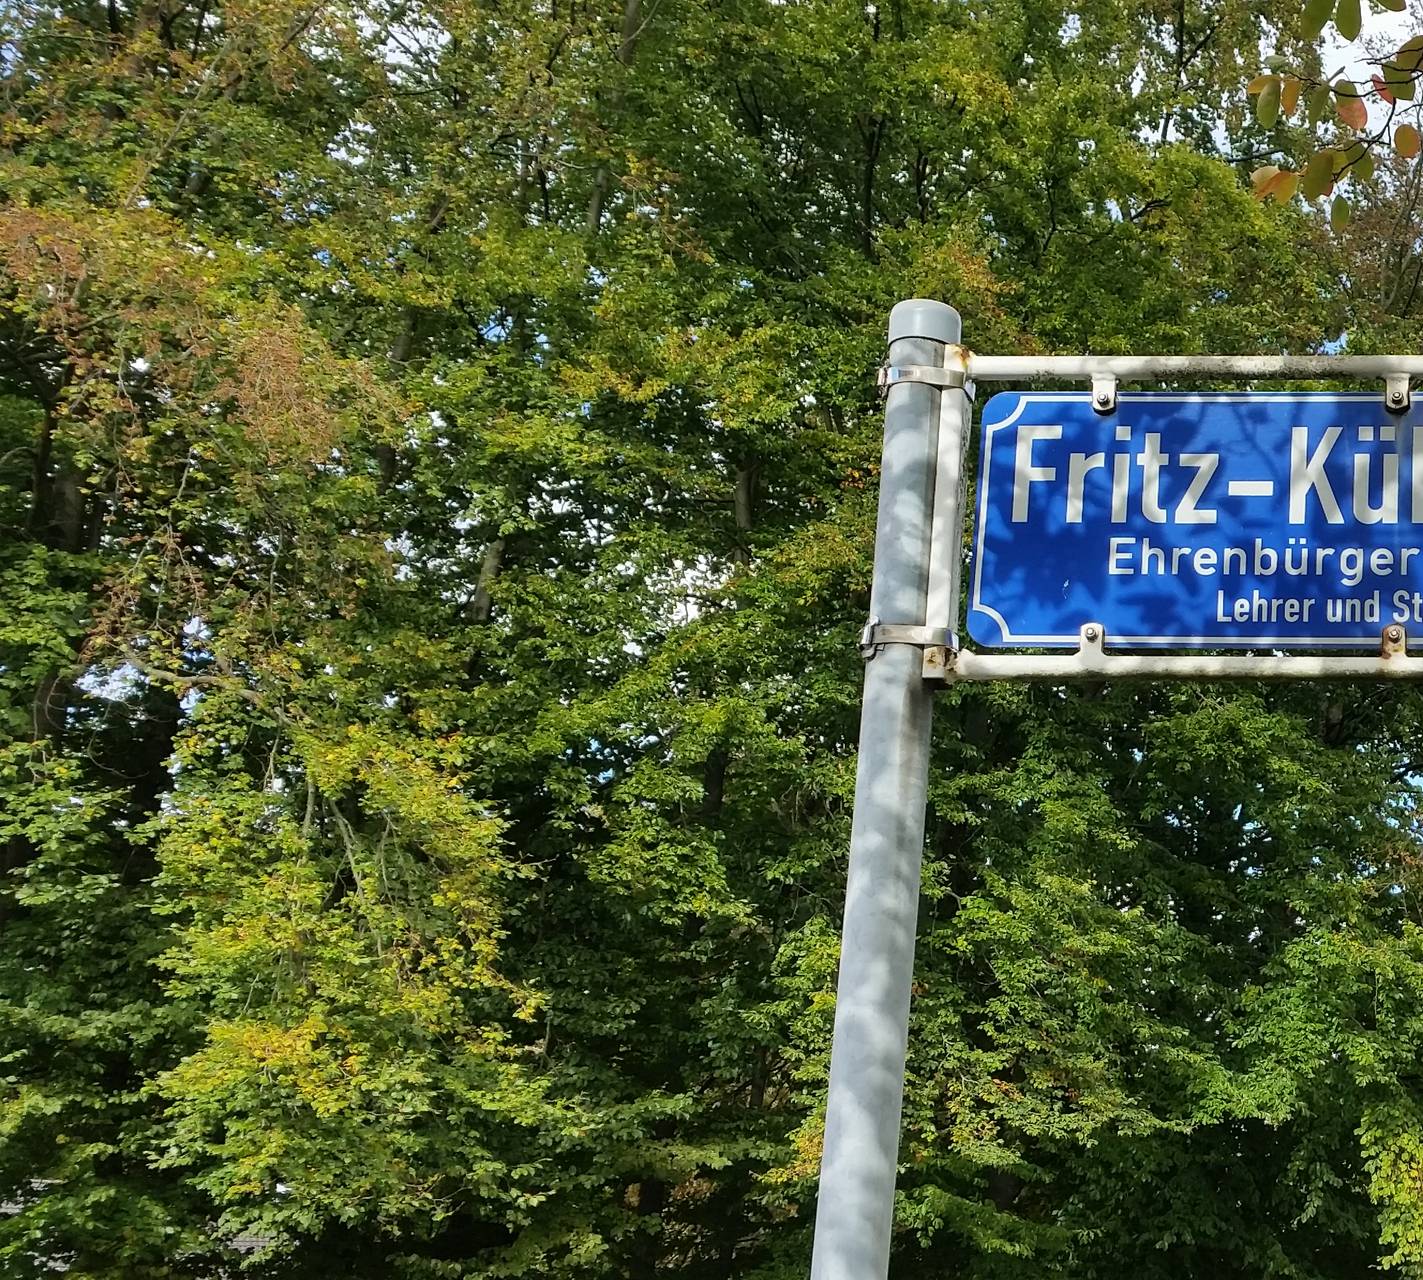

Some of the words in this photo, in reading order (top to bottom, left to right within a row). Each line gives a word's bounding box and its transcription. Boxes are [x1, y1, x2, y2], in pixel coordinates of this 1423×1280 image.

[1108, 537, 1419, 587] Ehrenbürger
[1216, 590, 1315, 623] Lehrer
[1326, 590, 1380, 623] und
